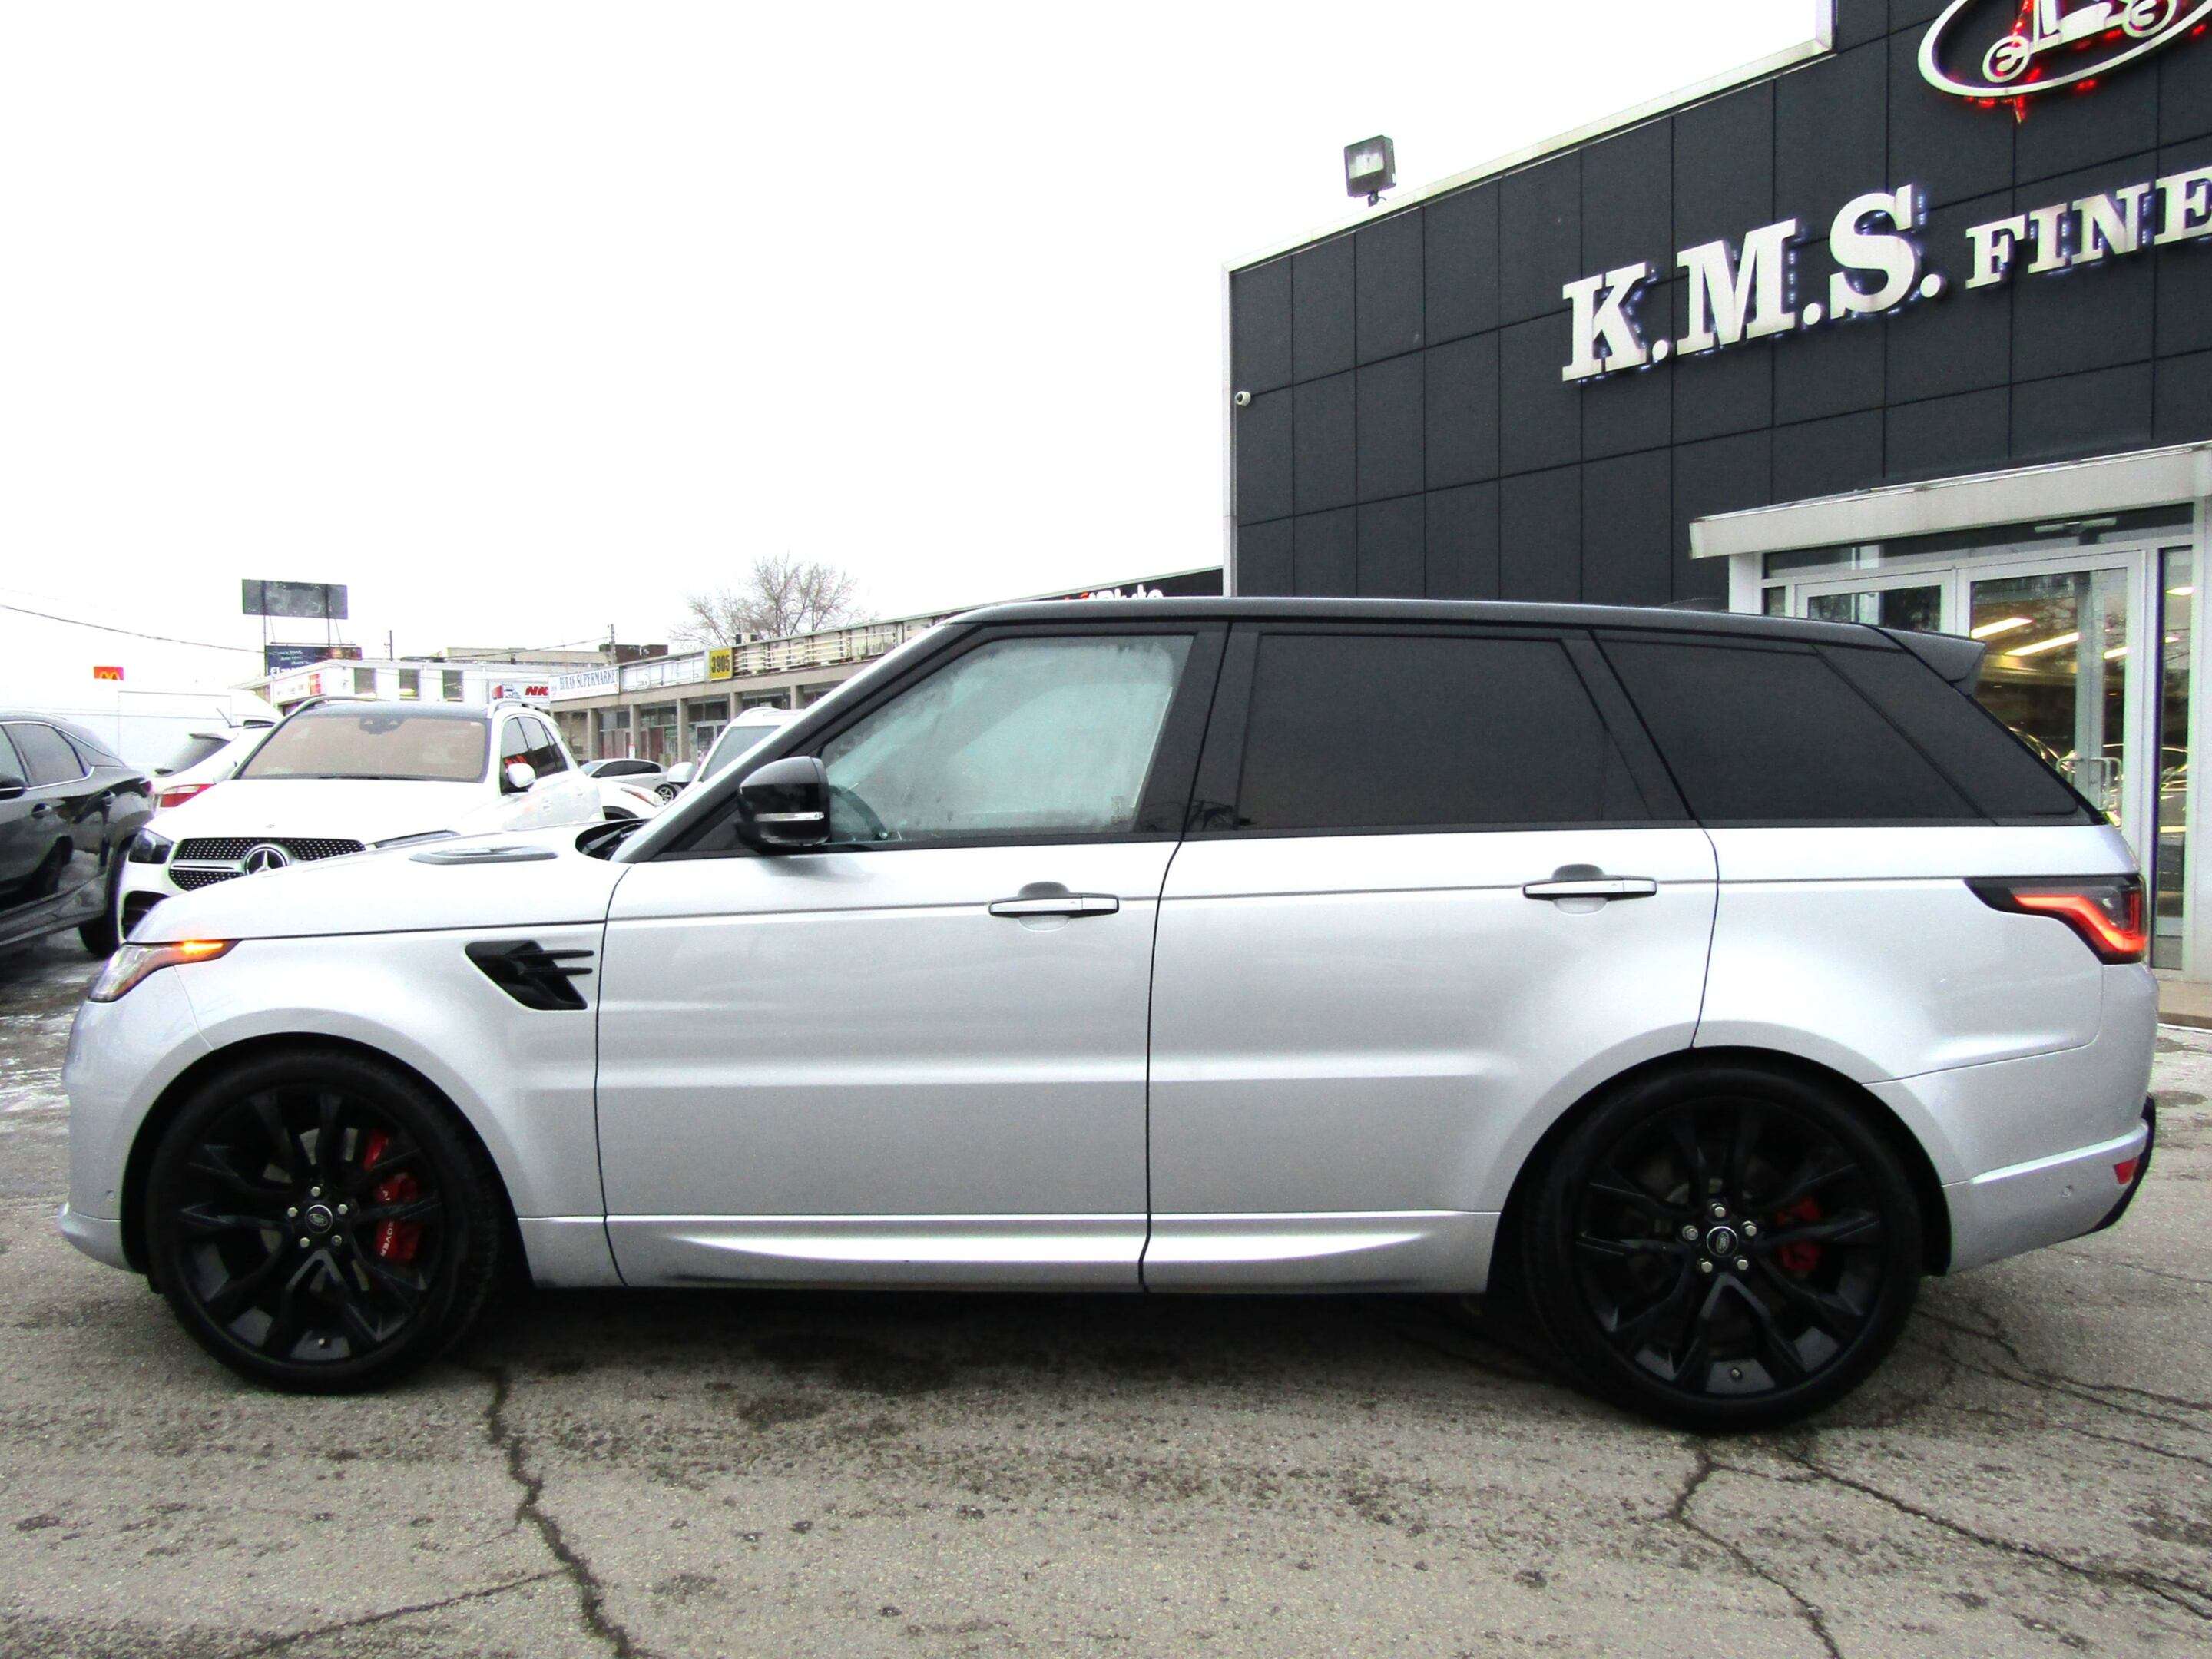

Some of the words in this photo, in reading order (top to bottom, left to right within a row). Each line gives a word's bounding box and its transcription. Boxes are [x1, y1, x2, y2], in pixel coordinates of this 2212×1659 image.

[1561, 184, 1942, 382] K.M.S.
[1965, 165, 2212, 290] FINE
[711, 654, 730, 674] 3905
[576, 668, 618, 689] SUPERMARKET
